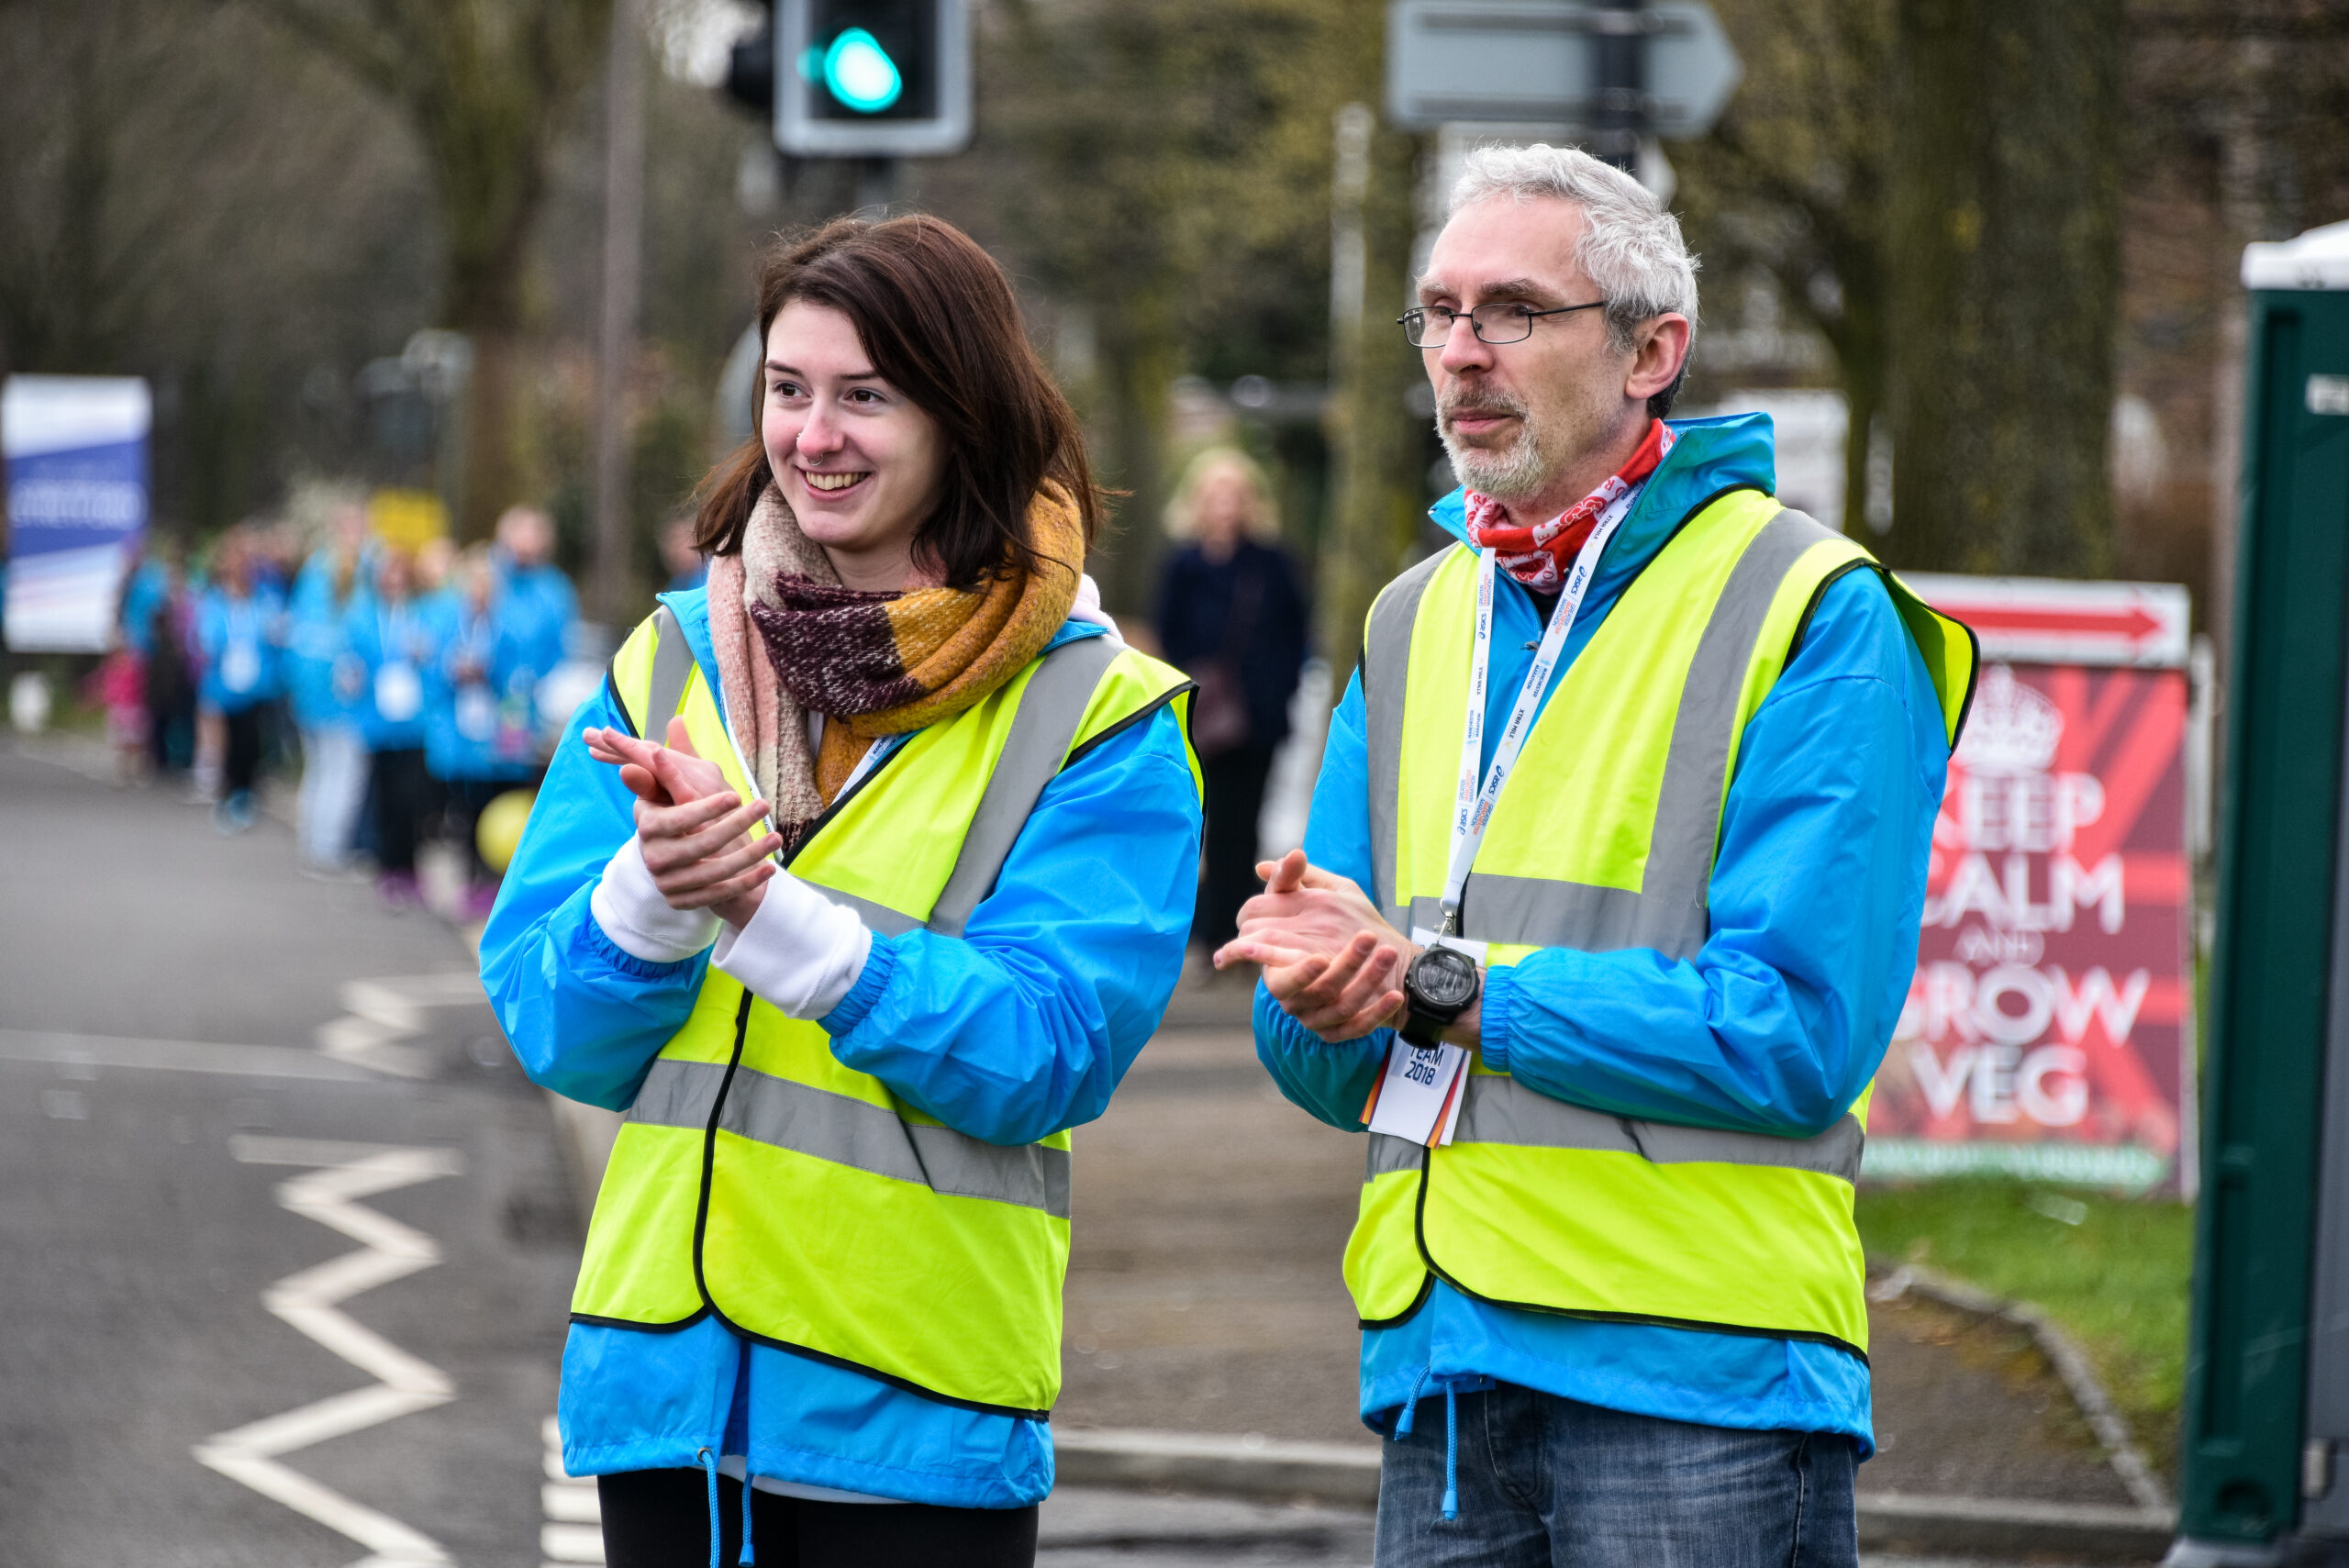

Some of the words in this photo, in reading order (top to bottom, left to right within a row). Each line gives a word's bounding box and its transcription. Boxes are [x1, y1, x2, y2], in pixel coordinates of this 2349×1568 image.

[1591, 528, 1603, 540] MILE
[1571, 575, 1582, 595] asics
[1553, 597, 1567, 626] MARATHON
[1564, 603, 1575, 627] GREATER
[1527, 663, 1540, 690] MARATHON
[1533, 667, 1548, 698] MANCHESTER
[1515, 708, 1524, 725] XTRA
[1508, 725, 1518, 740] MILE
[1488, 774, 1499, 795] asics
[1471, 798, 1485, 827] MARATHON
[1920, 851, 2124, 935] ALM
[1952, 923, 2045, 967] AND
[1404, 1060, 1436, 1085] 2018
[1909, 1043, 2088, 1127] VEG
